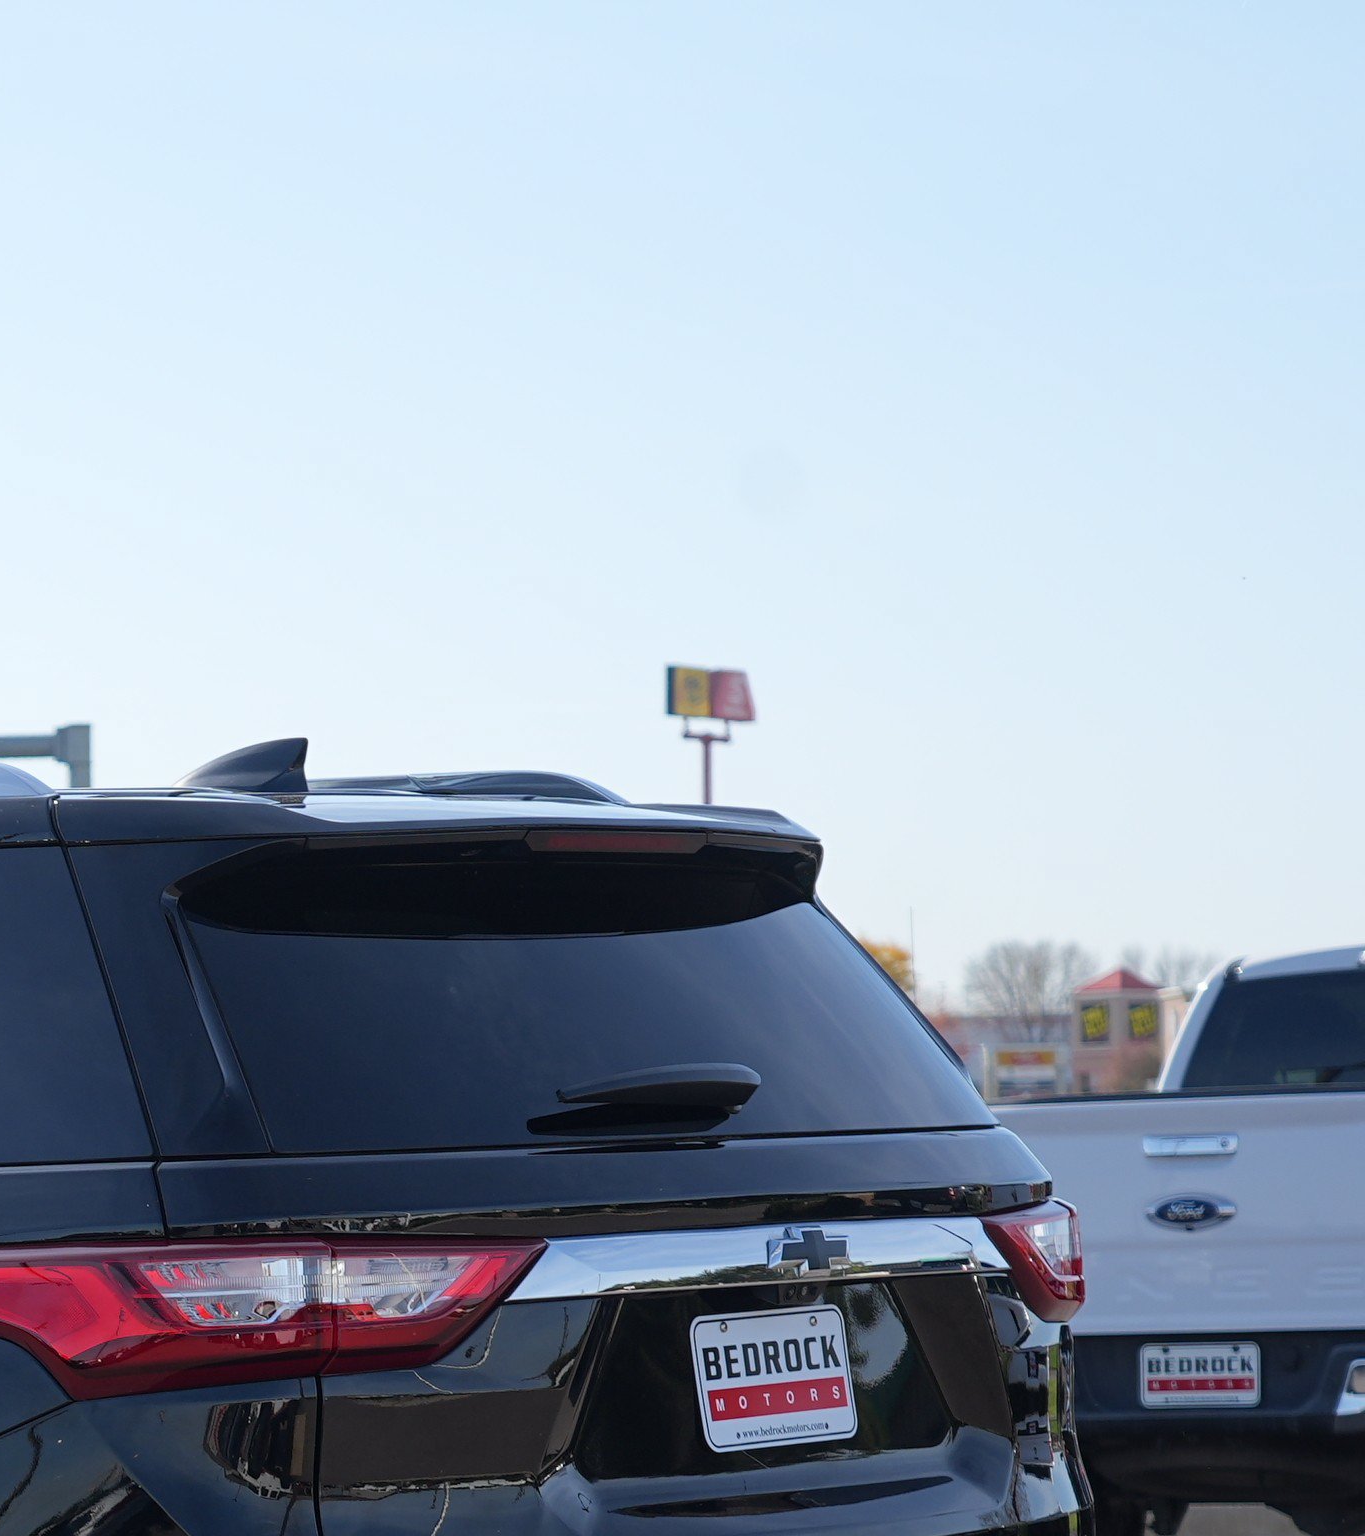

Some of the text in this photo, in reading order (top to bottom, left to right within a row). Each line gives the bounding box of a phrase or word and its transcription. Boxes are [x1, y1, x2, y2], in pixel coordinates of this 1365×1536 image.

[1167, 1200, 1206, 1221] Ford
[701, 1334, 842, 1381] BEDROCK
[1147, 1356, 1254, 1373] BEDROCK
[715, 1385, 841, 1412] MOTORS
[741, 1421, 825, 1439] www.bedrockmotors.com
